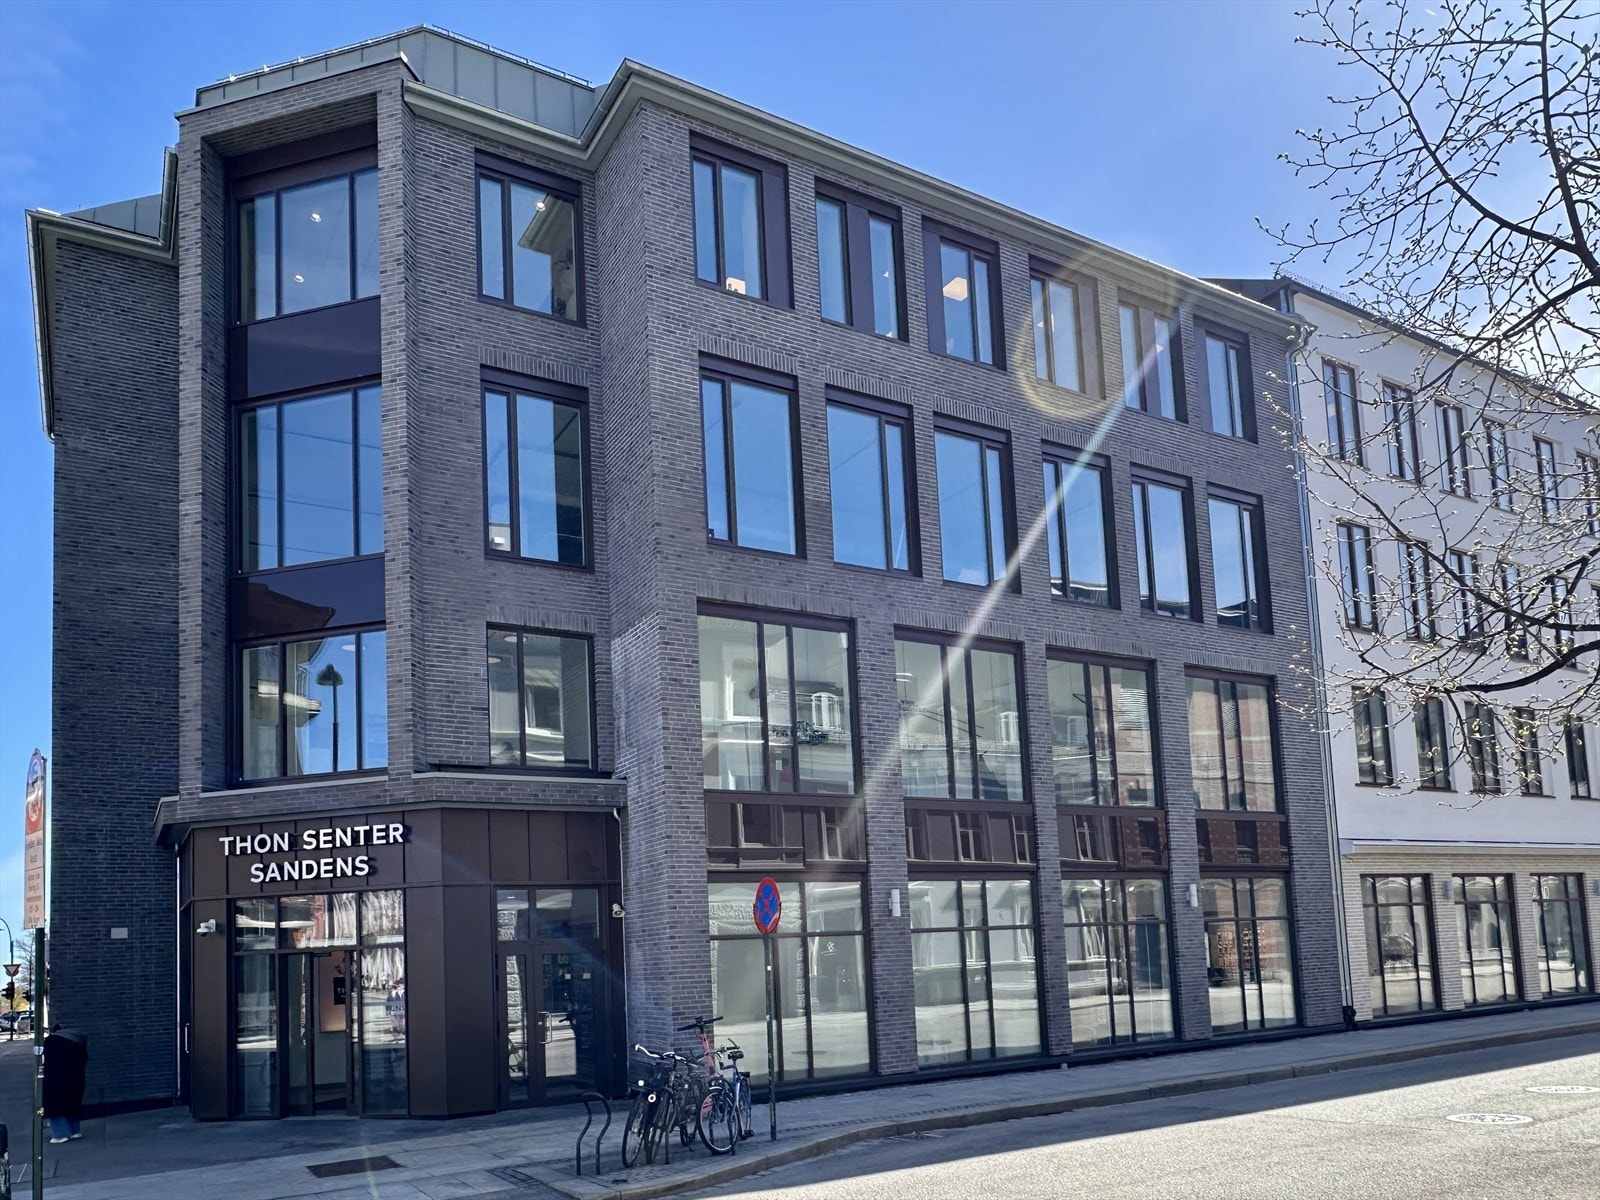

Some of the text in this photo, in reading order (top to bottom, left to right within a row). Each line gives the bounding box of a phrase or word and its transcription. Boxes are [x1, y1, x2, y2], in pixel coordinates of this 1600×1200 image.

[219, 823, 404, 856] THON SENTER
[250, 855, 370, 883] SANDENS
